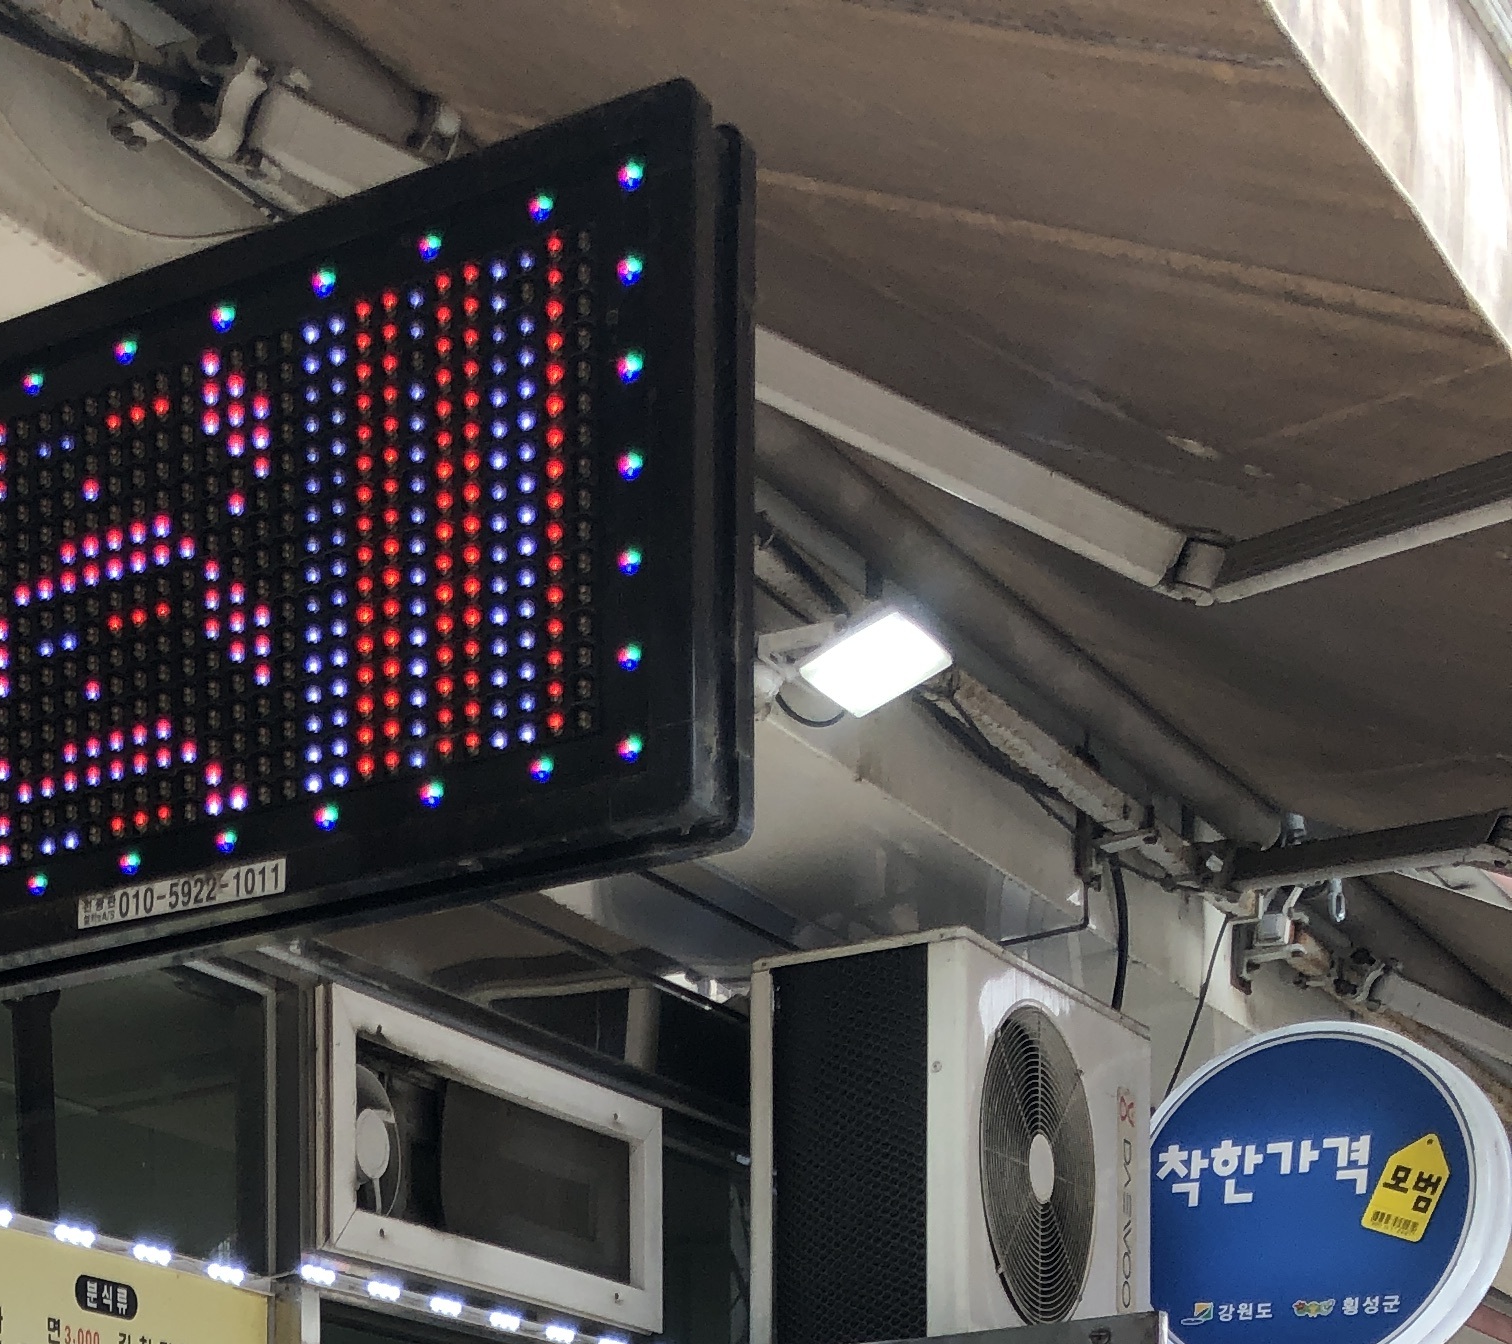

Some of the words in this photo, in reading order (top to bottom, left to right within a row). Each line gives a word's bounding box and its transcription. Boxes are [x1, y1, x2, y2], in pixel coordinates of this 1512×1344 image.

[118, 863, 279, 919] 010-5922-1011
[1156, 1133, 1373, 1208] 착한가격
[1382, 1162, 1444, 1217] 모범
[1121, 1137, 1133, 1310] DAEWOO
[86, 1279, 128, 1315] 분식류
[1217, 1299, 1274, 1323] 강원도
[1340, 1291, 1402, 1317] 횡성군
